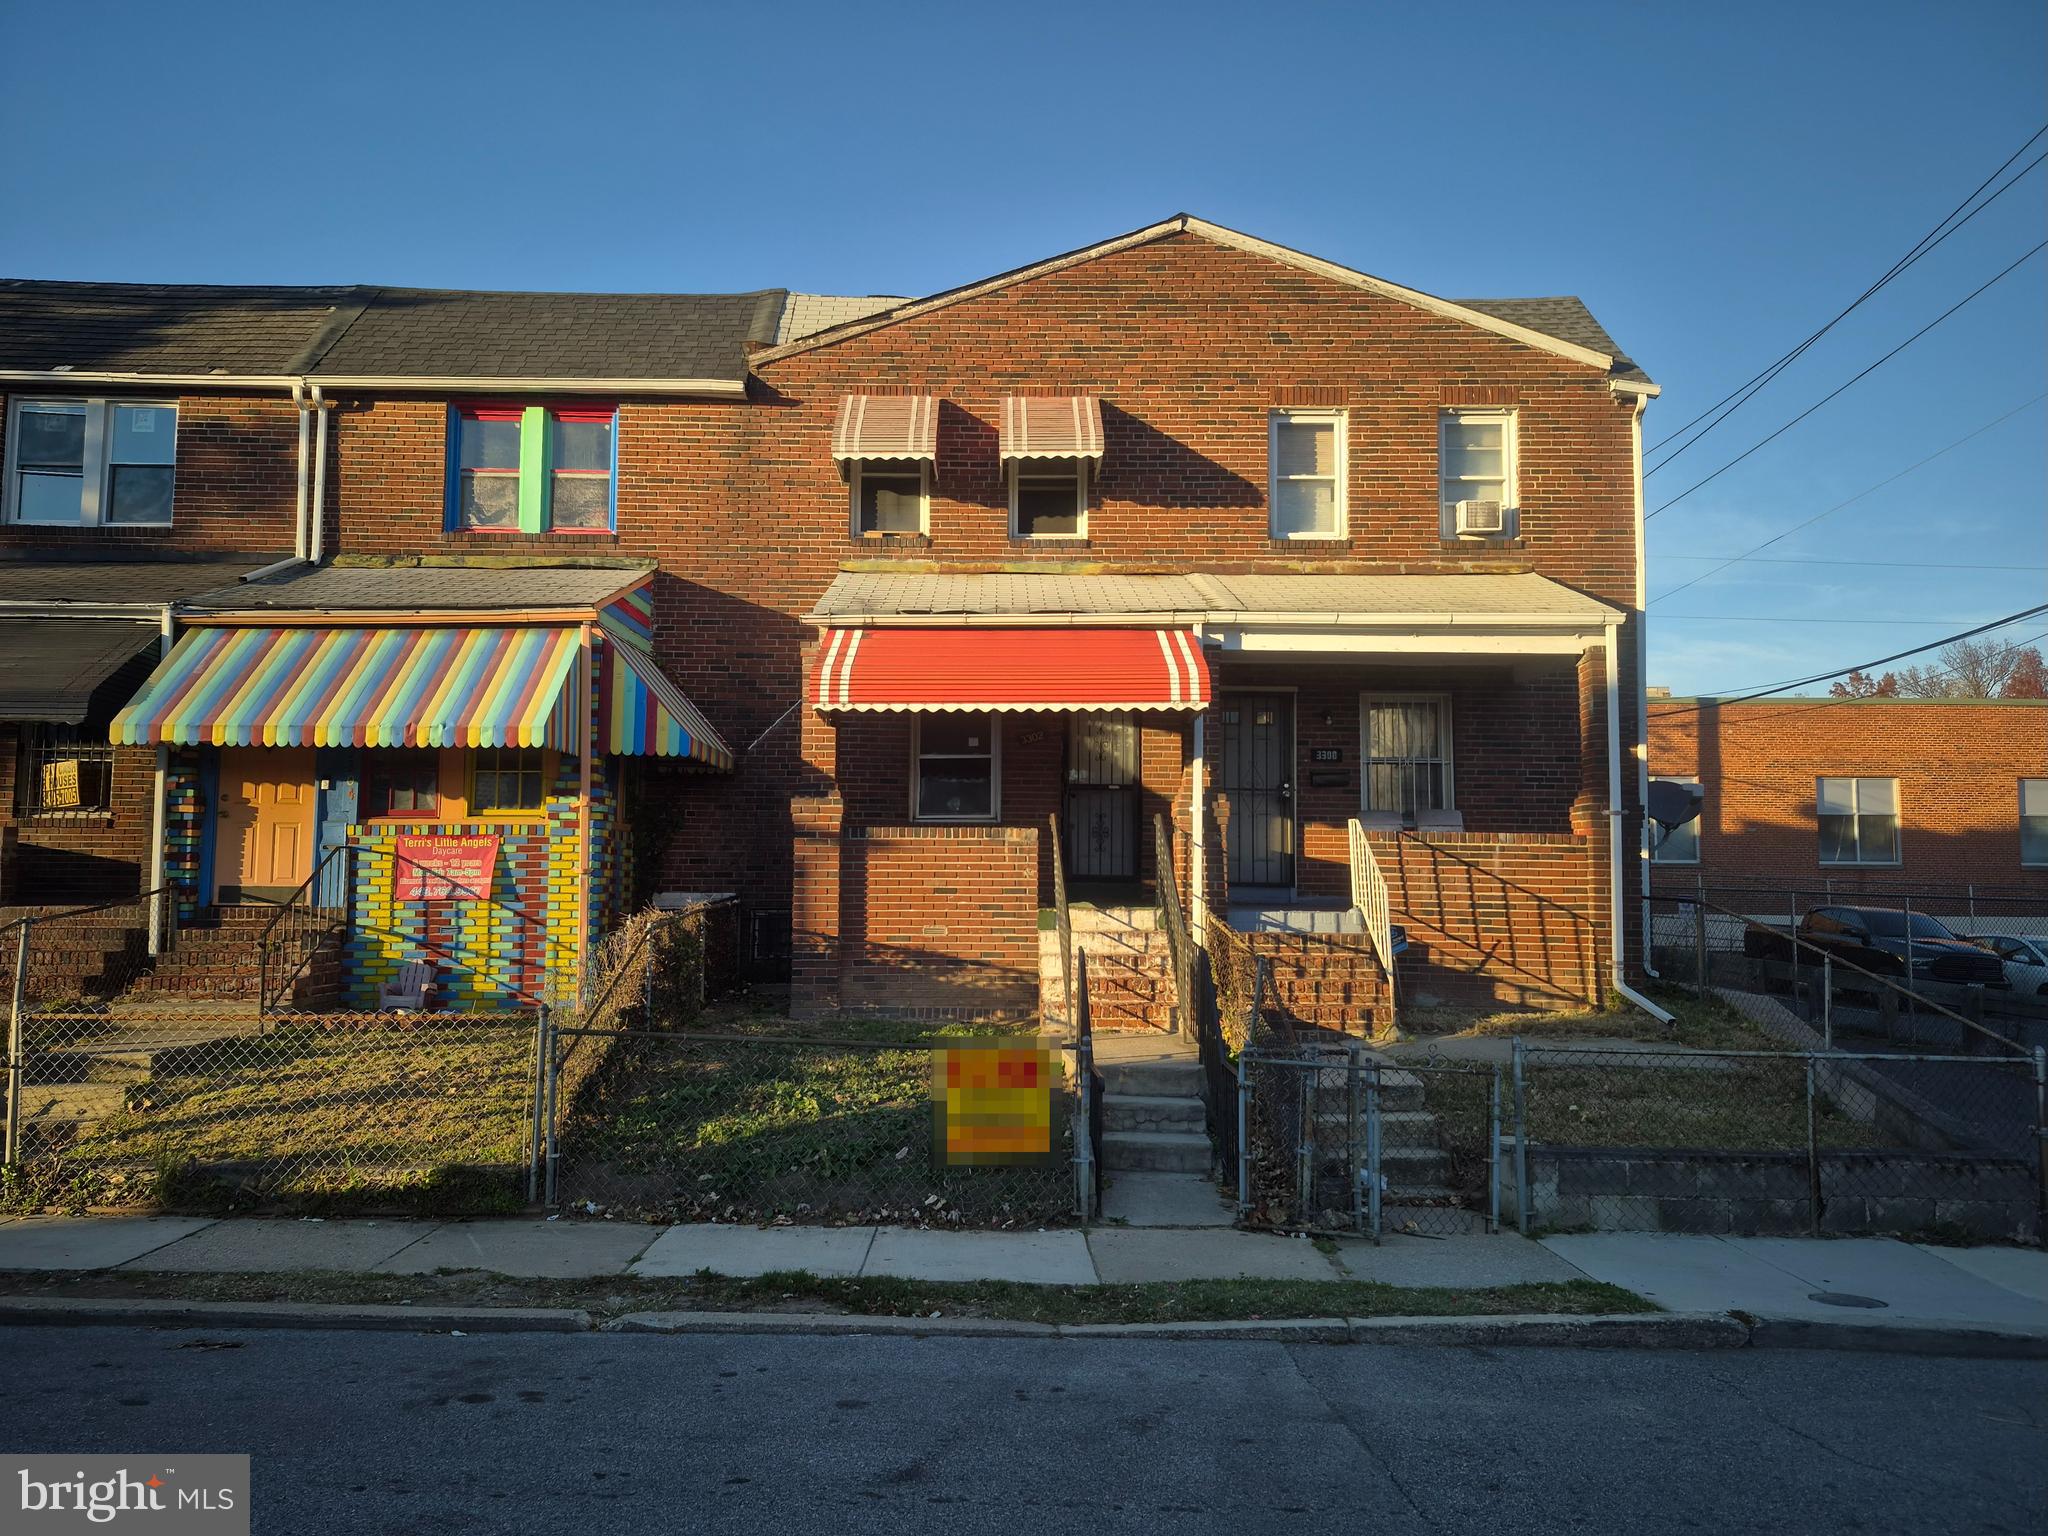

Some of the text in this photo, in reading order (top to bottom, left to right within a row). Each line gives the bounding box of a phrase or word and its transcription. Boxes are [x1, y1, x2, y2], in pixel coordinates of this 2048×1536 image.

[404, 838, 492, 848] Terri's Little Angels
[433, 847, 462, 856] Daycare
